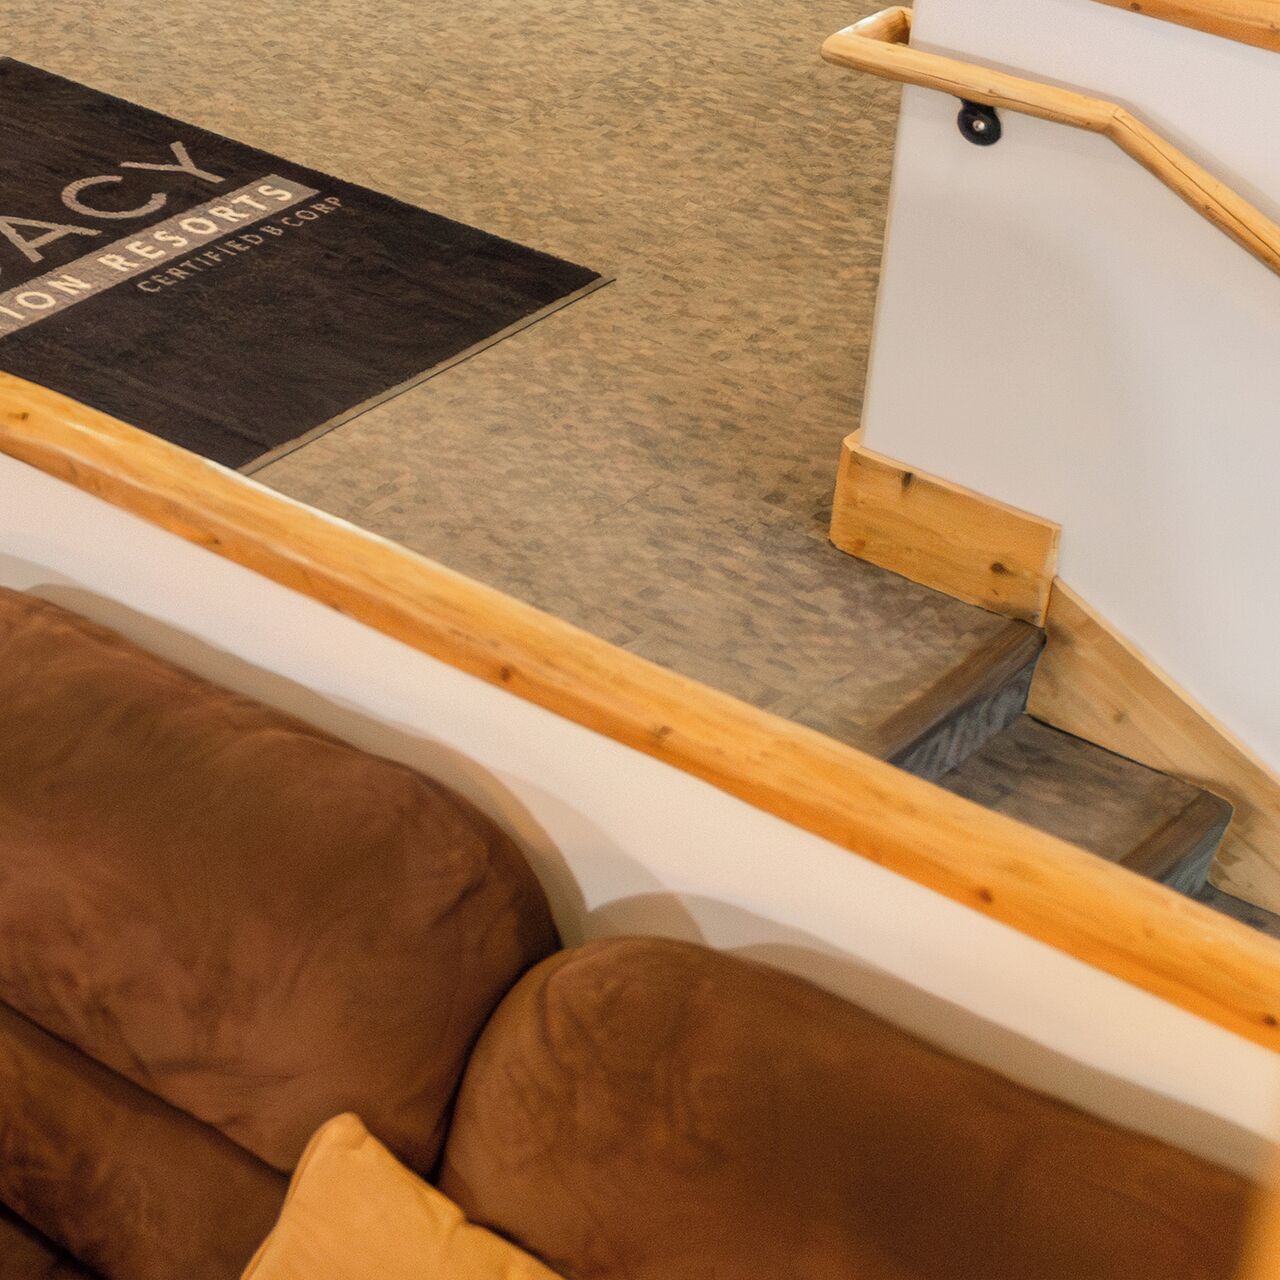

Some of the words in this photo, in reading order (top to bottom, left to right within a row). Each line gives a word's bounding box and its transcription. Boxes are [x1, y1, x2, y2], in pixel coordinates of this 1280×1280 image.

[98, 183, 293, 273] RESORTS
[137, 234, 263, 293] CERTIFIED
[262, 224, 284, 238] B
[283, 195, 343, 228] CORP
